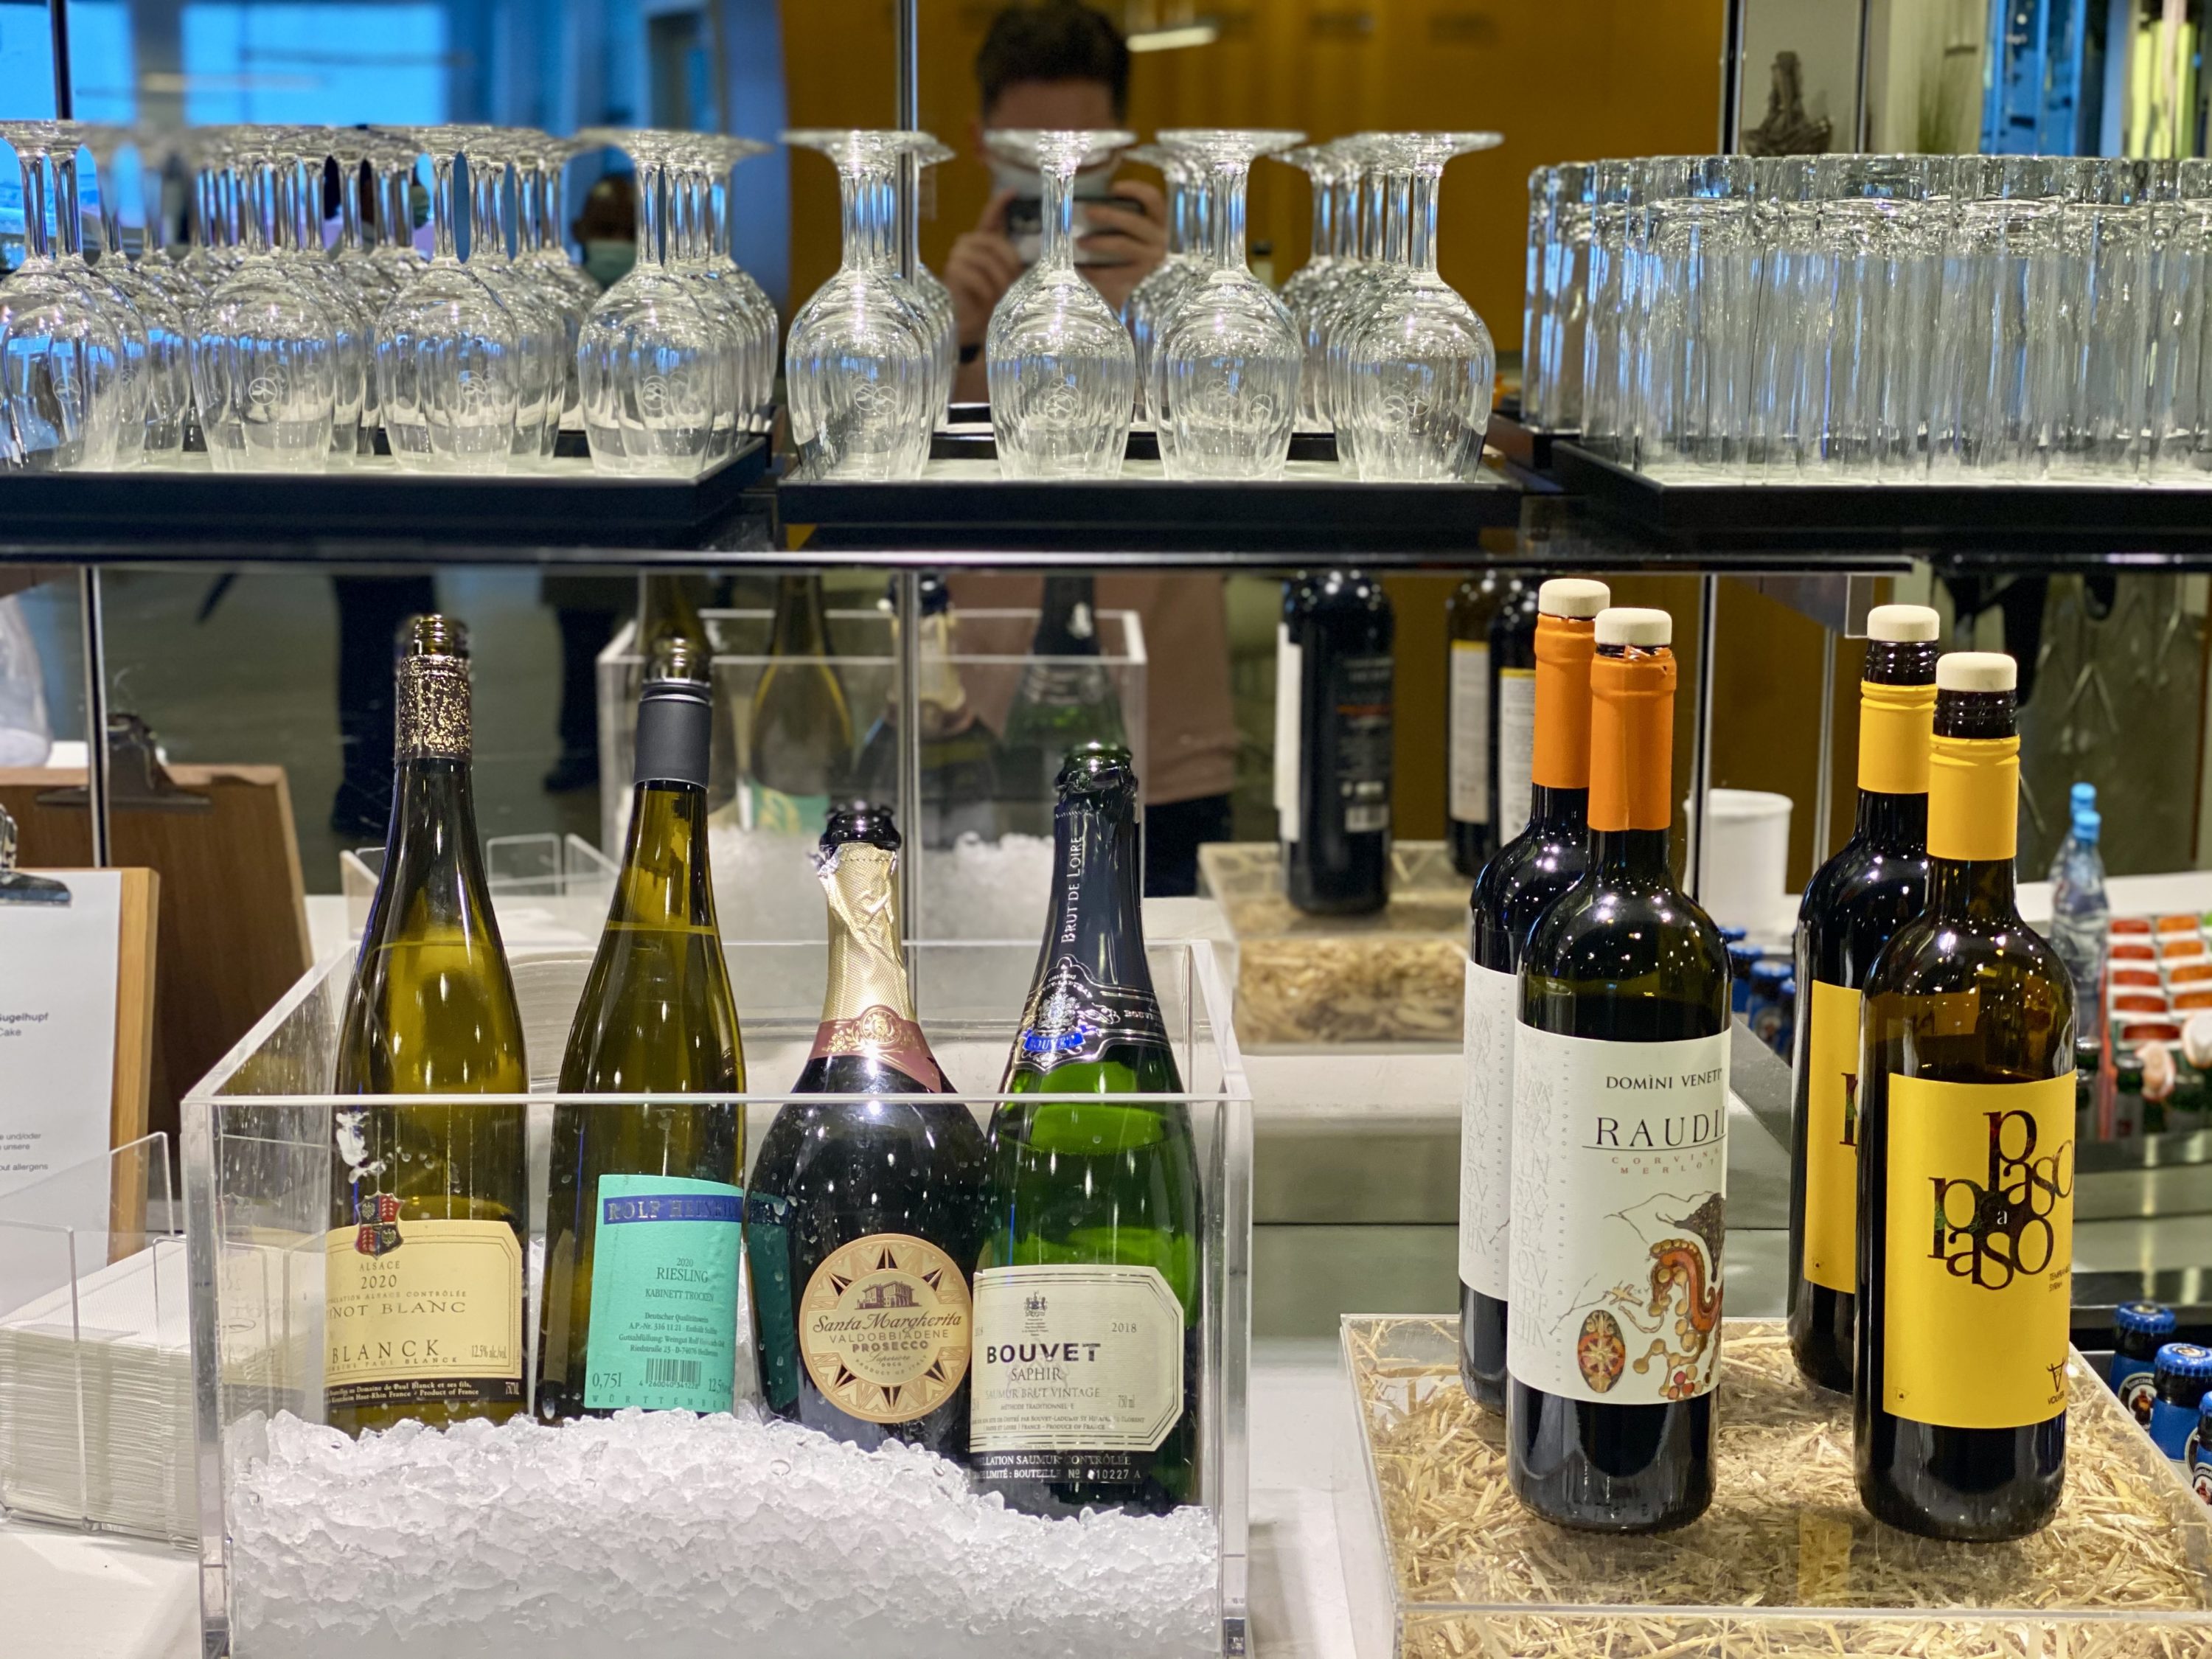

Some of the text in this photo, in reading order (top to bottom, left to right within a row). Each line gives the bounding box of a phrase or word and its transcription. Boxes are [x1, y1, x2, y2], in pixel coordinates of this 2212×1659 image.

[1061, 836, 1082, 943] BRUT DE LOIRE
[1606, 1074, 1673, 1089] DOMÌNI
[13, 1163, 49, 1172] allergens
[608, 1201, 661, 1220] ROLF
[360, 1261, 400, 1272] ALSACE
[676, 1257, 694, 1267] 2020
[656, 1267, 708, 1283] RIESLING
[361, 1275, 397, 1290] 2020
[645, 1288, 714, 1302] KABINETT TROCKEN
[329, 1300, 466, 1319] INOT BLANC
[644, 1312, 674, 1321] Deutscher
[813, 1315, 862, 1333] Santa
[862, 1310, 962, 1334] Margherita
[1111, 1323, 1137, 1333] 2018
[830, 1329, 949, 1343] VALDOBBIADENE
[333, 1340, 439, 1364] BLANCK
[852, 1340, 928, 1353] PROSECCO
[987, 1343, 1101, 1364] BOUVET
[405, 1357, 457, 1366] BLANCK
[592, 1371, 622, 1389] 0,75l
[1011, 1367, 1062, 1381] SAPHIR
[1021, 1388, 1047, 1398] BRUT
[1051, 1387, 1100, 1399] VINTAGE
